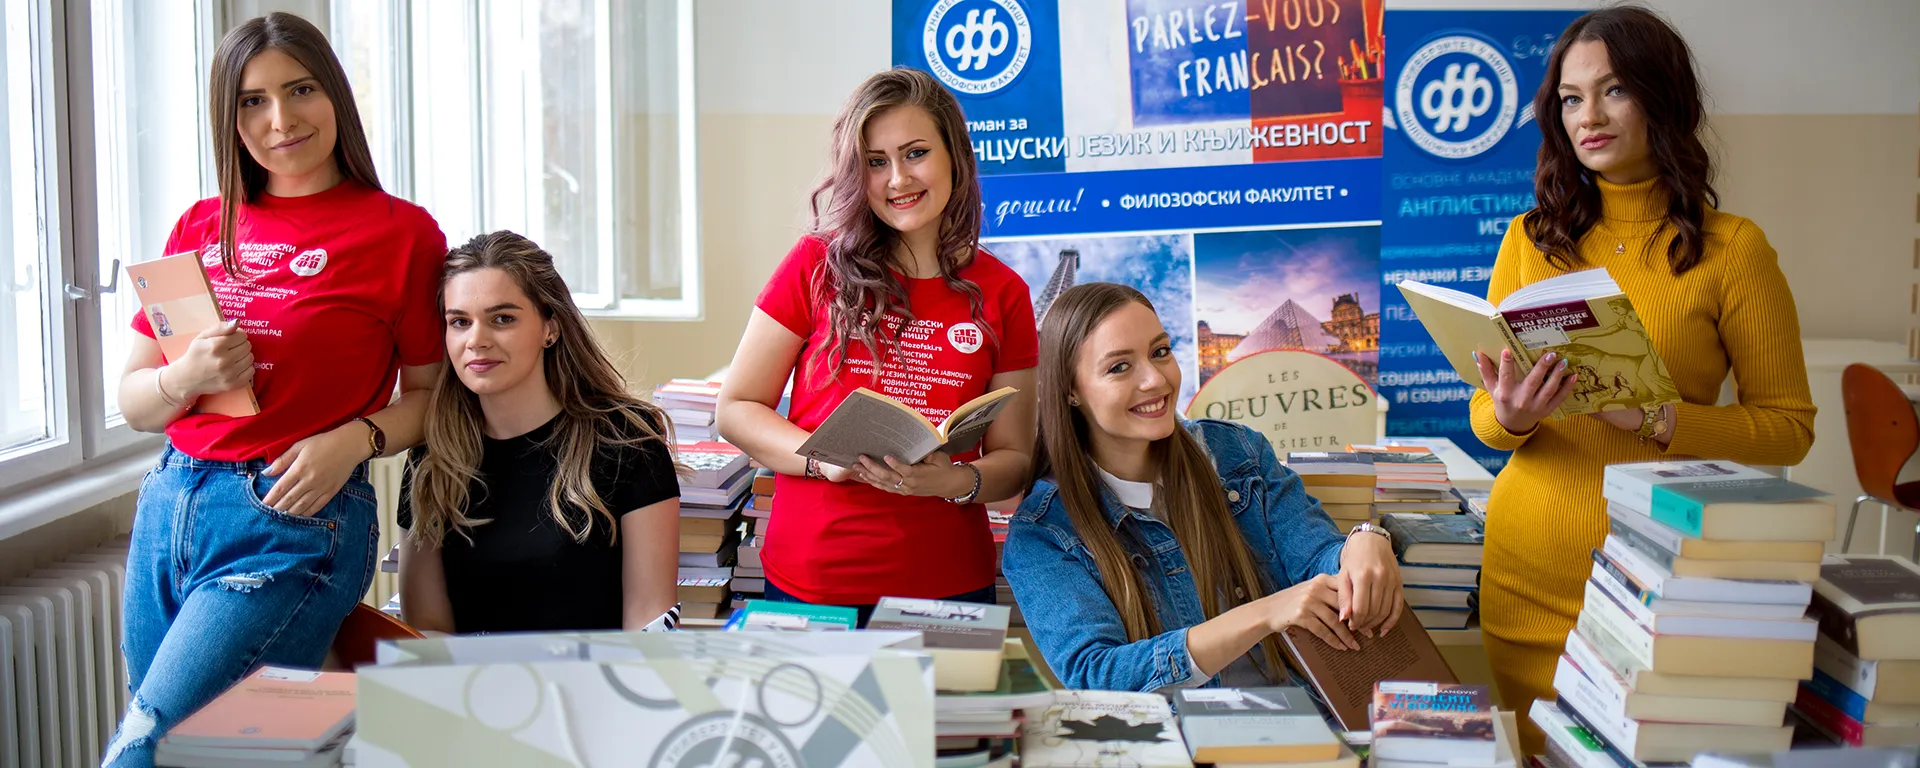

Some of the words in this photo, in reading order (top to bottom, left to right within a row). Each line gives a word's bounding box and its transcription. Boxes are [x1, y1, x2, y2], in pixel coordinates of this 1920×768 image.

[928, 51, 988, 91] ФИЛОЗОФСКИ
[990, 46, 1029, 88] ФАКУЛТЕТ
[1178, 40, 1325, 97] FRANÇAIS?
[965, 118, 1005, 132] тман
[1009, 117, 1028, 130] за
[970, 136, 1070, 164] НЦУСКИ
[1077, 131, 1151, 157] ЈЕЗИК
[1158, 131, 1176, 153] И
[1183, 121, 1372, 153] КЊИЖЕВНОСТ
[1119, 189, 1241, 210] ФИЛОЗОФСКИ
[1244, 185, 1336, 205] ФАКУЛТЕТ
[1399, 193, 1537, 217] АНГЛИСТИКА
[218, 300, 246, 309] АГОГИЈА
[222, 309, 246, 317] ЛОГИЈА
[1539, 307, 1568, 317] TEJLOR
[1510, 320, 1535, 329] KRAJ
[1535, 311, 1588, 325] EVROPSKE
[268, 329, 282, 337] РАД
[901, 331, 930, 341] НИШУ
[888, 348, 933, 359] АНЛИСТИКА
[886, 370, 907, 379] ЈЕЗИК
[914, 374, 965, 388] КЊИЖЕВНОСТ
[1268, 370, 1300, 384] LES
[883, 385, 927, 397] ПЕДАГОГИЈА
[1273, 422, 1288, 431] DE
